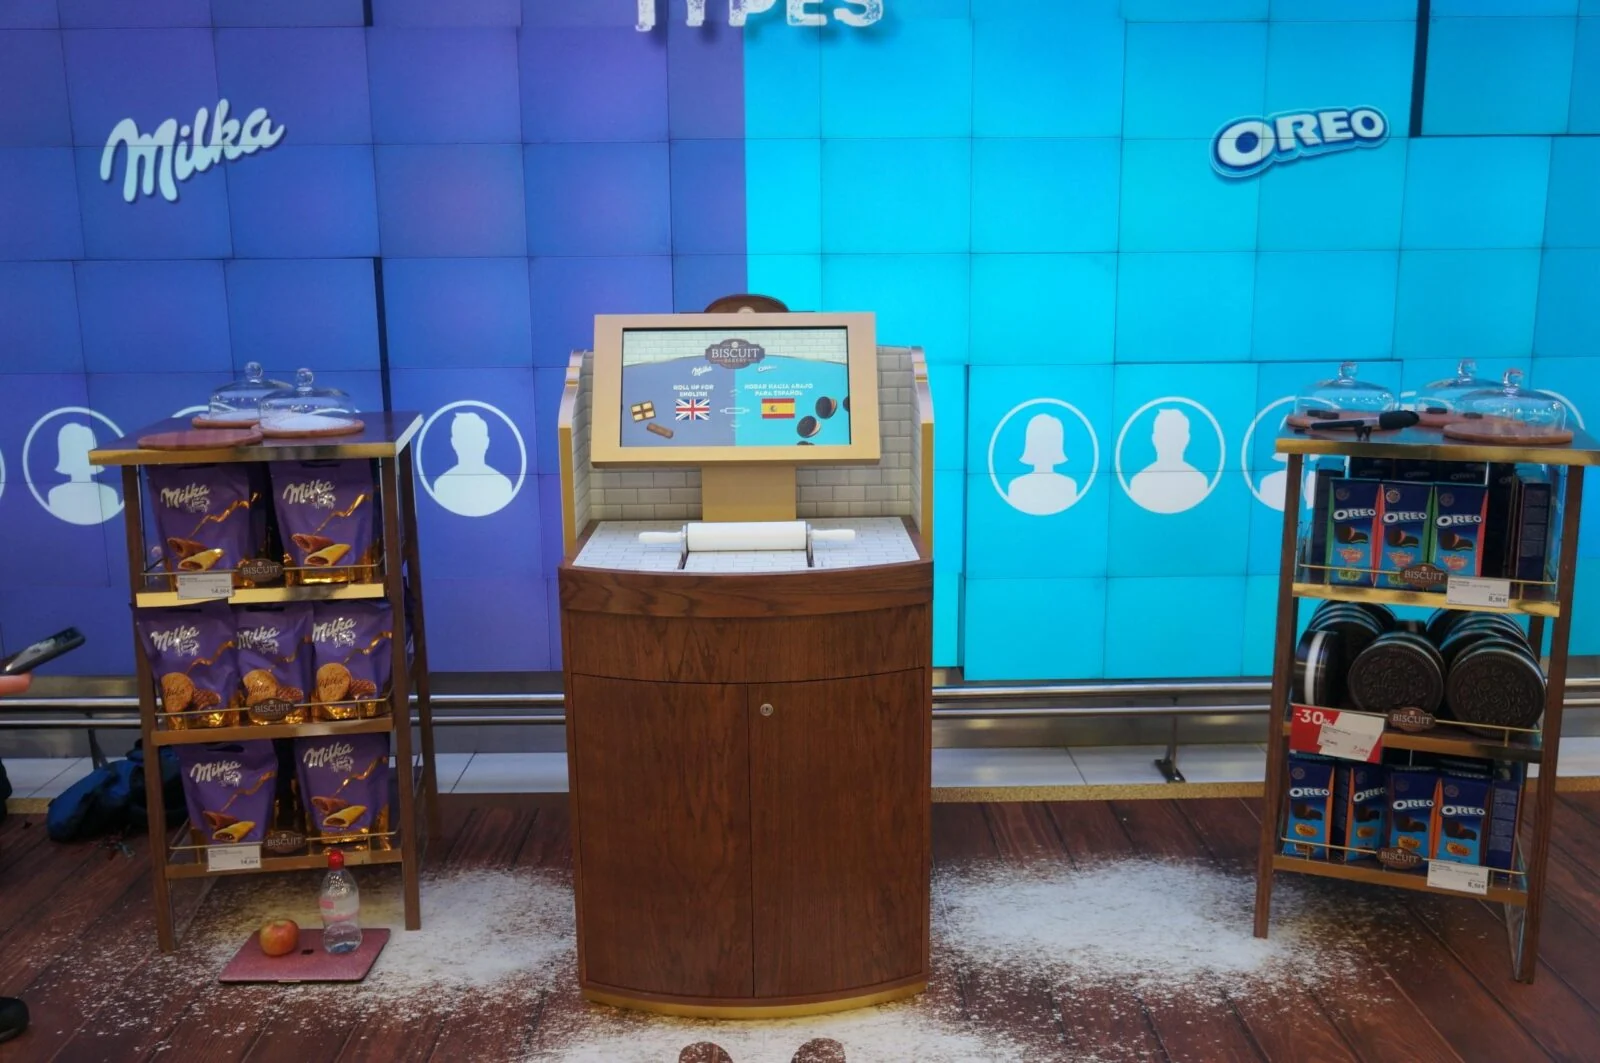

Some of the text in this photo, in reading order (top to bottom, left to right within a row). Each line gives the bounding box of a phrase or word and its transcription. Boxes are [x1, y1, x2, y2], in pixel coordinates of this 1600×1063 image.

[1216, 108, 1385, 168] OREO
[100, 98, 285, 202] Milka
[711, 348, 760, 358] BISCUIT
[160, 482, 210, 509] Milka
[283, 479, 336, 505] Milka
[1333, 508, 1377, 521] OREO
[1383, 511, 1428, 524] OREO
[1436, 514, 1482, 527] OREO
[243, 564, 279, 576] BISCUIT
[1404, 570, 1444, 581] BISCUIT
[312, 616, 357, 643] Milka
[151, 625, 200, 652] Milka
[237, 625, 281, 650] Milka
[254, 703, 291, 714] BISCUIT
[1392, 713, 1432, 726] BISCUIT
[303, 742, 354, 768] Milka
[190, 760, 242, 784] Milka
[1289, 787, 1330, 798] OREO
[1353, 786, 1386, 802] OREO
[1392, 799, 1435, 810] OREO
[1441, 805, 1486, 816] OREO
[267, 835, 302, 848] BISCUIT
[1380, 851, 1418, 864] BISCUIT
